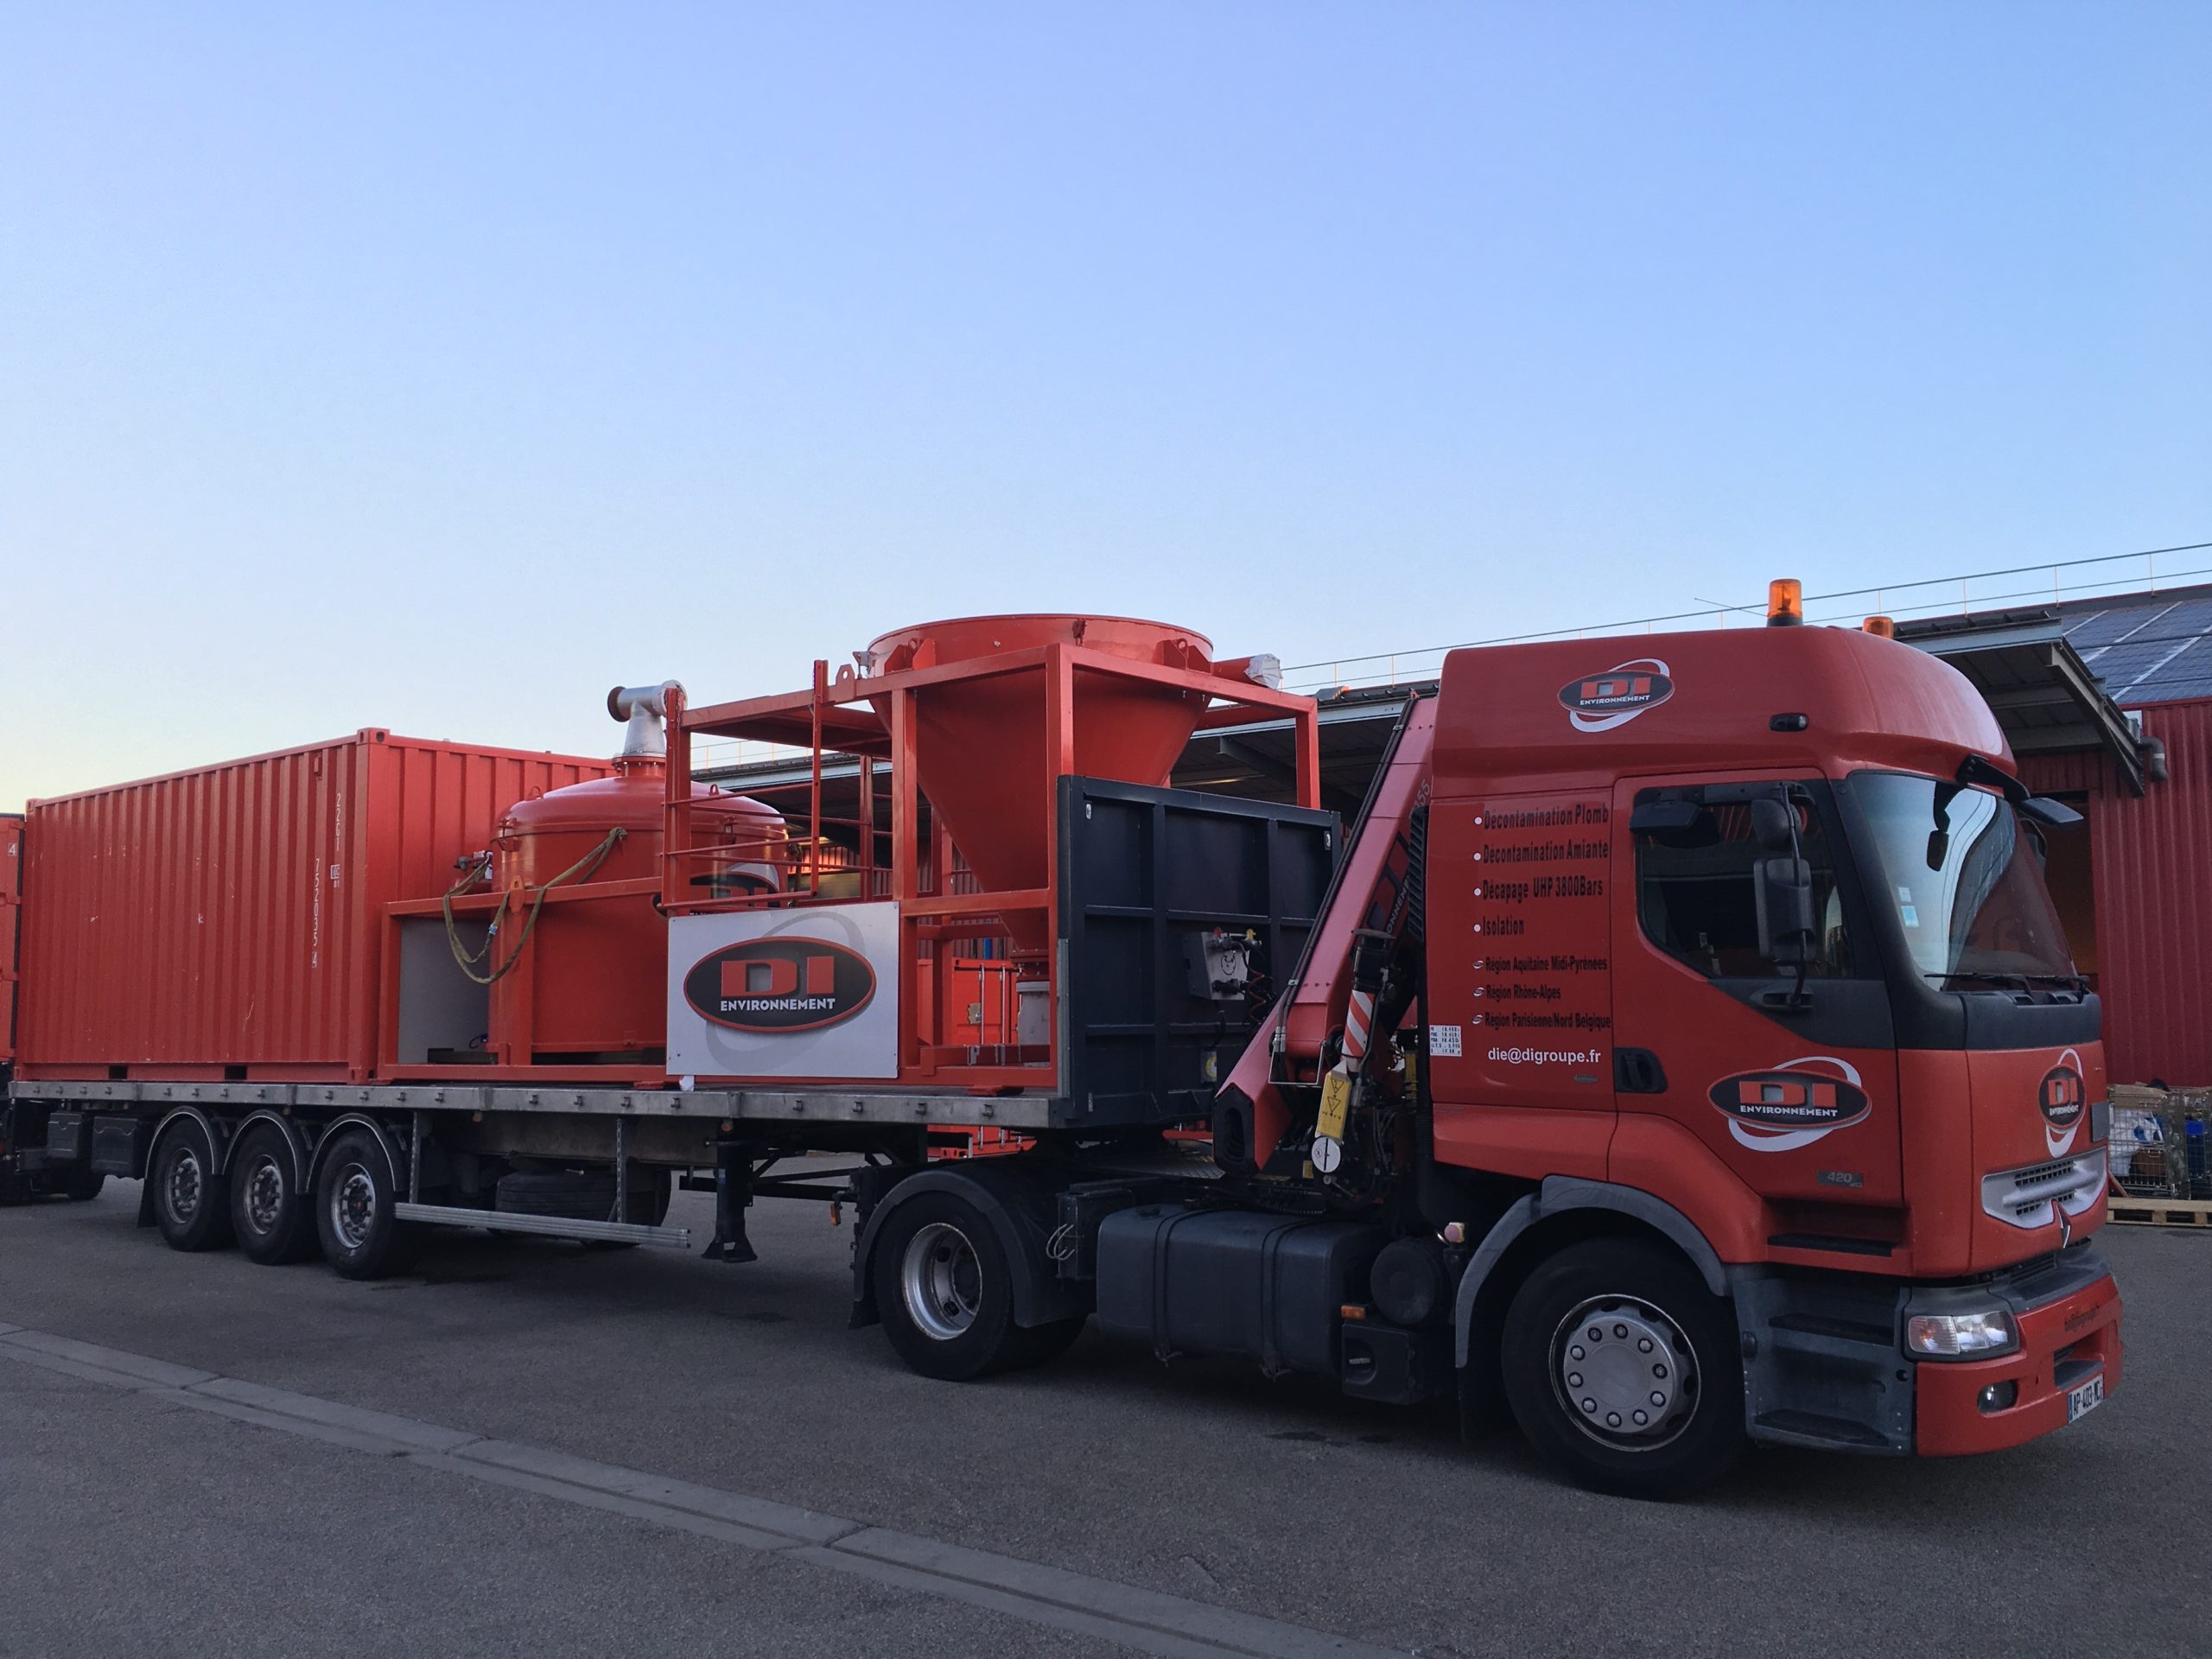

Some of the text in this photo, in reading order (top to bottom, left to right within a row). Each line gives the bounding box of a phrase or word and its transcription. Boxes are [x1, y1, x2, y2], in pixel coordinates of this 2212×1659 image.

[1580, 677, 1652, 699] DI
[1580, 695, 1651, 706] ENVIRONNEMENT
[1575, 803, 1609, 824] Plomb
[8, 843, 16, 855] 4
[1483, 838, 1609, 864] Décontamination Amiante
[1483, 879, 1529, 904] Décapage
[1533, 877, 1553, 899] UHP
[1483, 914, 1524, 937] Isolation
[1513, 956, 1549, 975] Aquitaine
[721, 956, 835, 997] DI
[720, 998, 836, 1012] ENVIRONNEMENT
[1575, 1012, 1611, 1032] Belgique
[1488, 1047, 1602, 1065] die@digroupe.fr
[1739, 1081, 1837, 1107] DI
[2048, 1077, 2078, 1105] DI
[1740, 1105, 1838, 1117] ENVIRONNEMENT
[1827, 1172, 1853, 1183] 420
